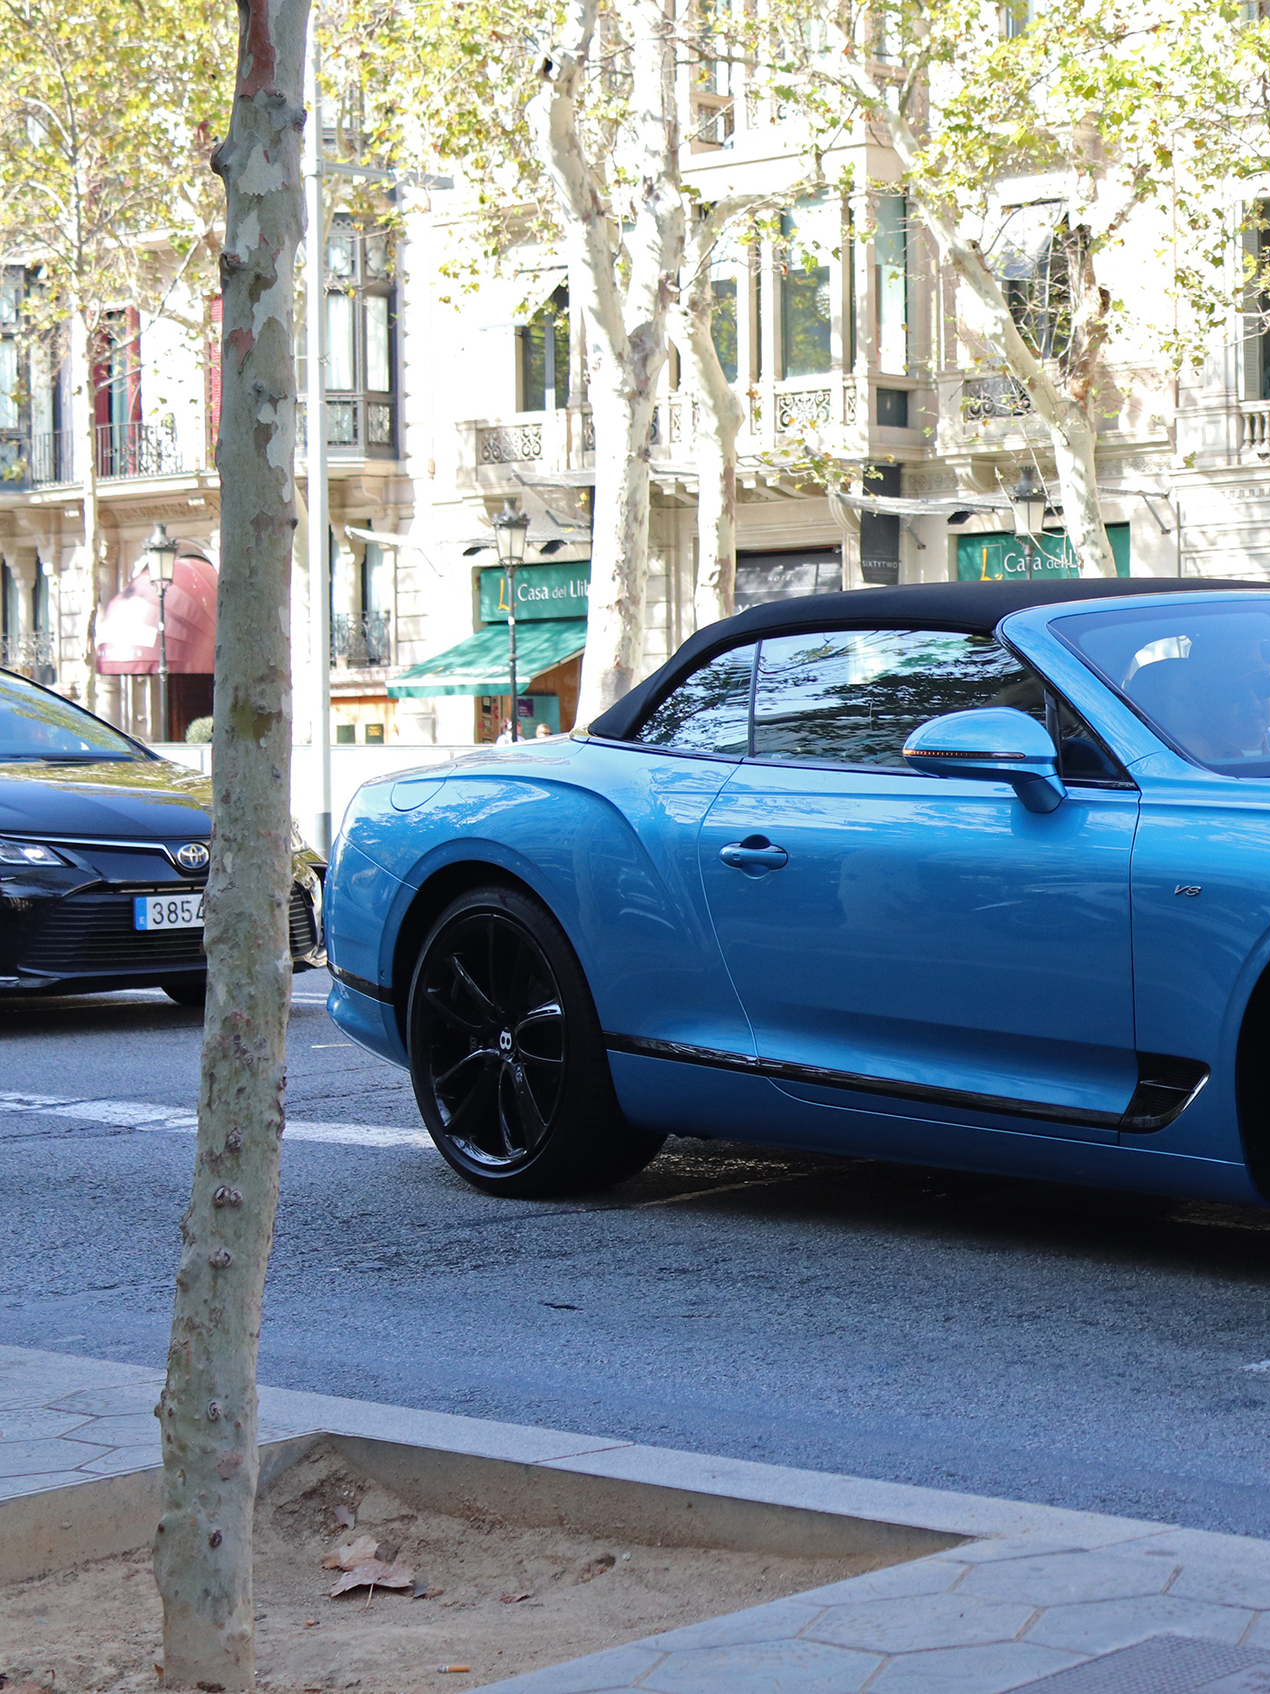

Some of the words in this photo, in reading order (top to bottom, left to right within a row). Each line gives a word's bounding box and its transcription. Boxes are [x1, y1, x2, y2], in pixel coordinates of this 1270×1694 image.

[862, 560, 898, 569] SIXTYTWO
[1004, 553, 1042, 573] Caa
[517, 583, 549, 601] Casa
[552, 586, 567, 599] del
[1174, 884, 1202, 896] V8
